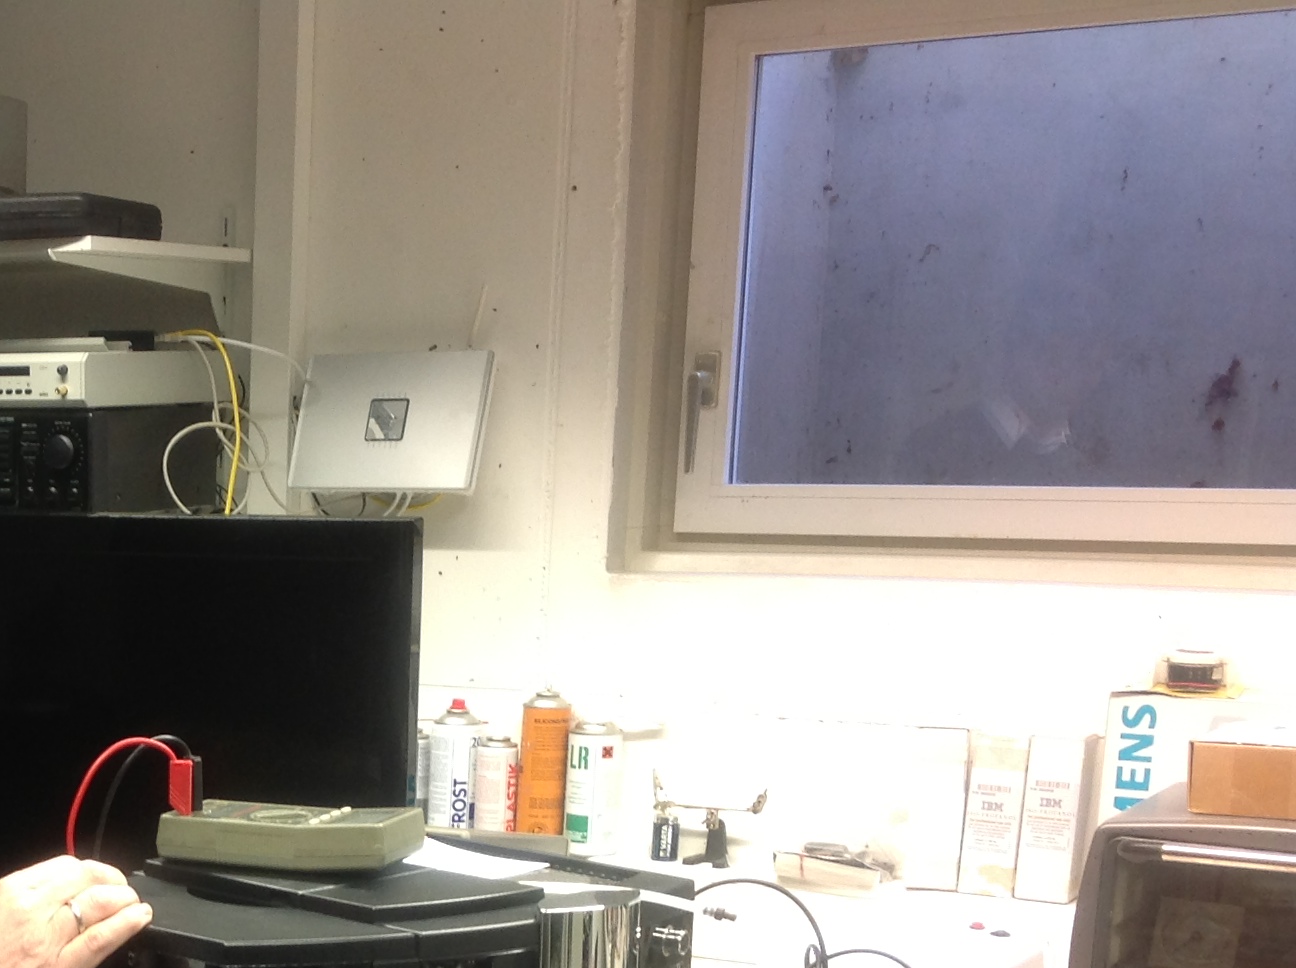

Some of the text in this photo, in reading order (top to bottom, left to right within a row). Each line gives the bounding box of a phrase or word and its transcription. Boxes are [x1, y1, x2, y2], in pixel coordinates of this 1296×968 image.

[570, 744, 590, 771] LR
[1113, 704, 1157, 812] ENS
[981, 801, 1004, 812] IBM
[1039, 797, 1063, 809] IBM
